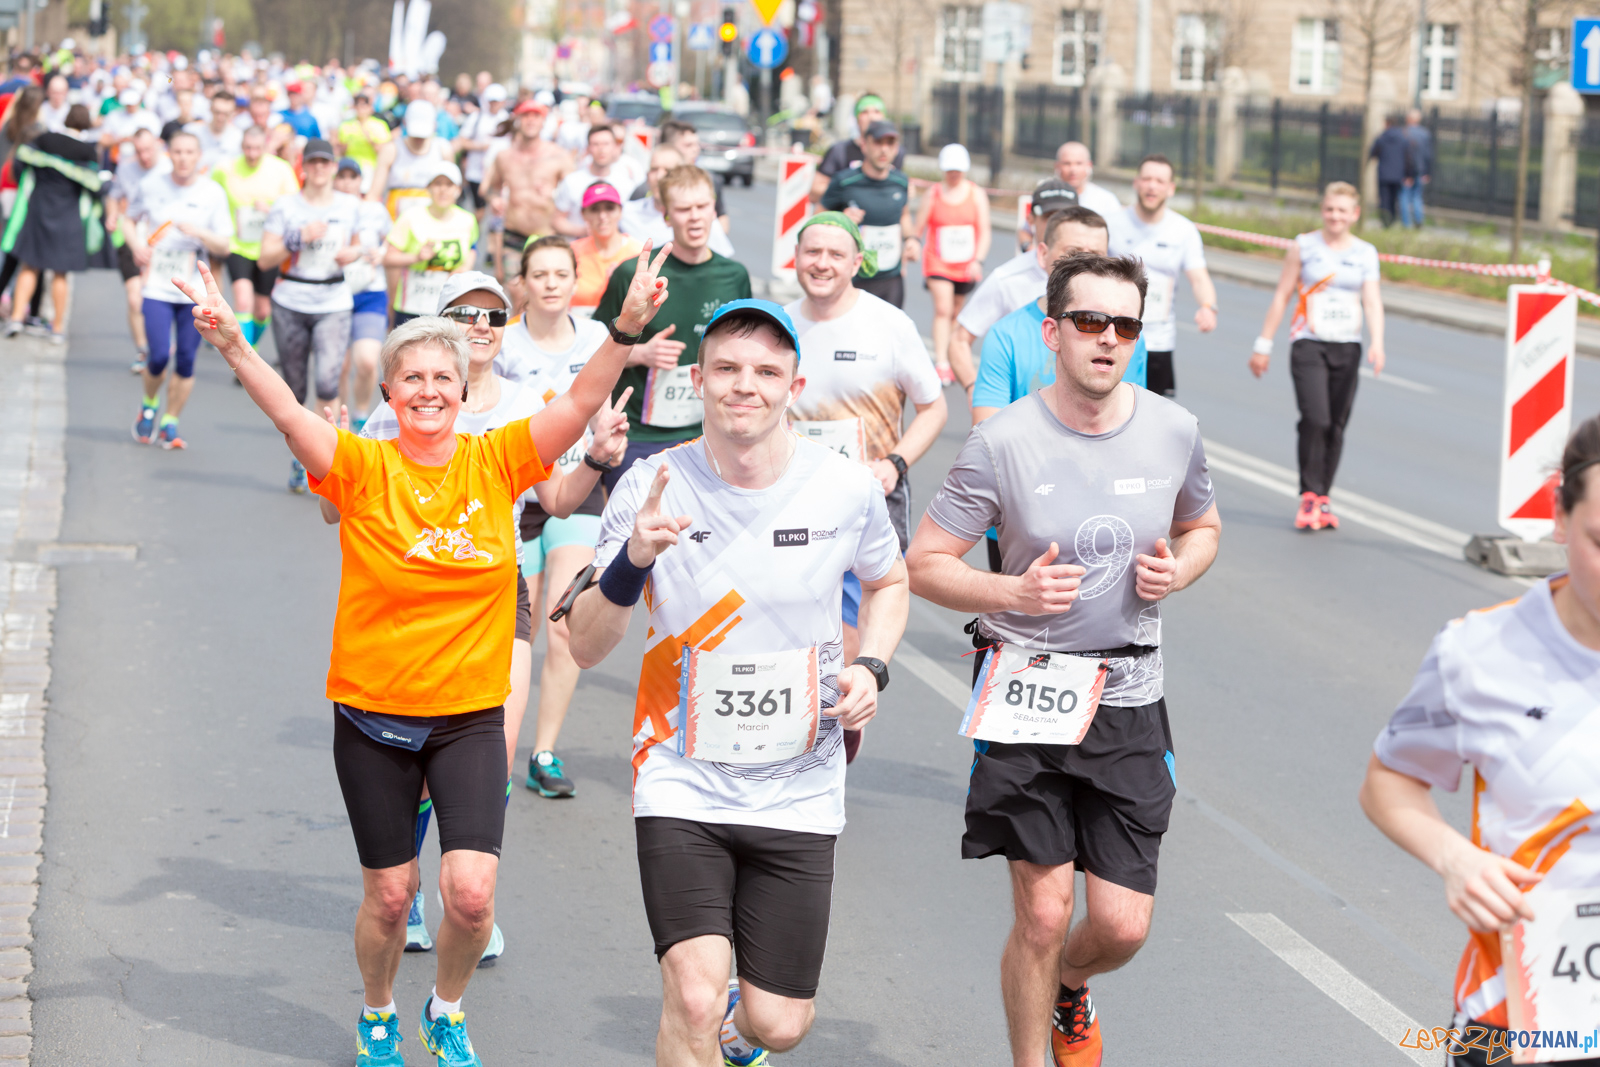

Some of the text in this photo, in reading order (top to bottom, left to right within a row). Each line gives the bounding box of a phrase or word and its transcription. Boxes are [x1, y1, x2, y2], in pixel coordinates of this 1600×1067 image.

[689, 530, 712, 544] 4F
[1074, 514, 1135, 601] 9
[714, 687, 792, 717] 3361
[1004, 679, 1078, 714] 8150
[737, 723, 770, 732] Marcin
[1012, 712, 1059, 724] SEBASTIAN
